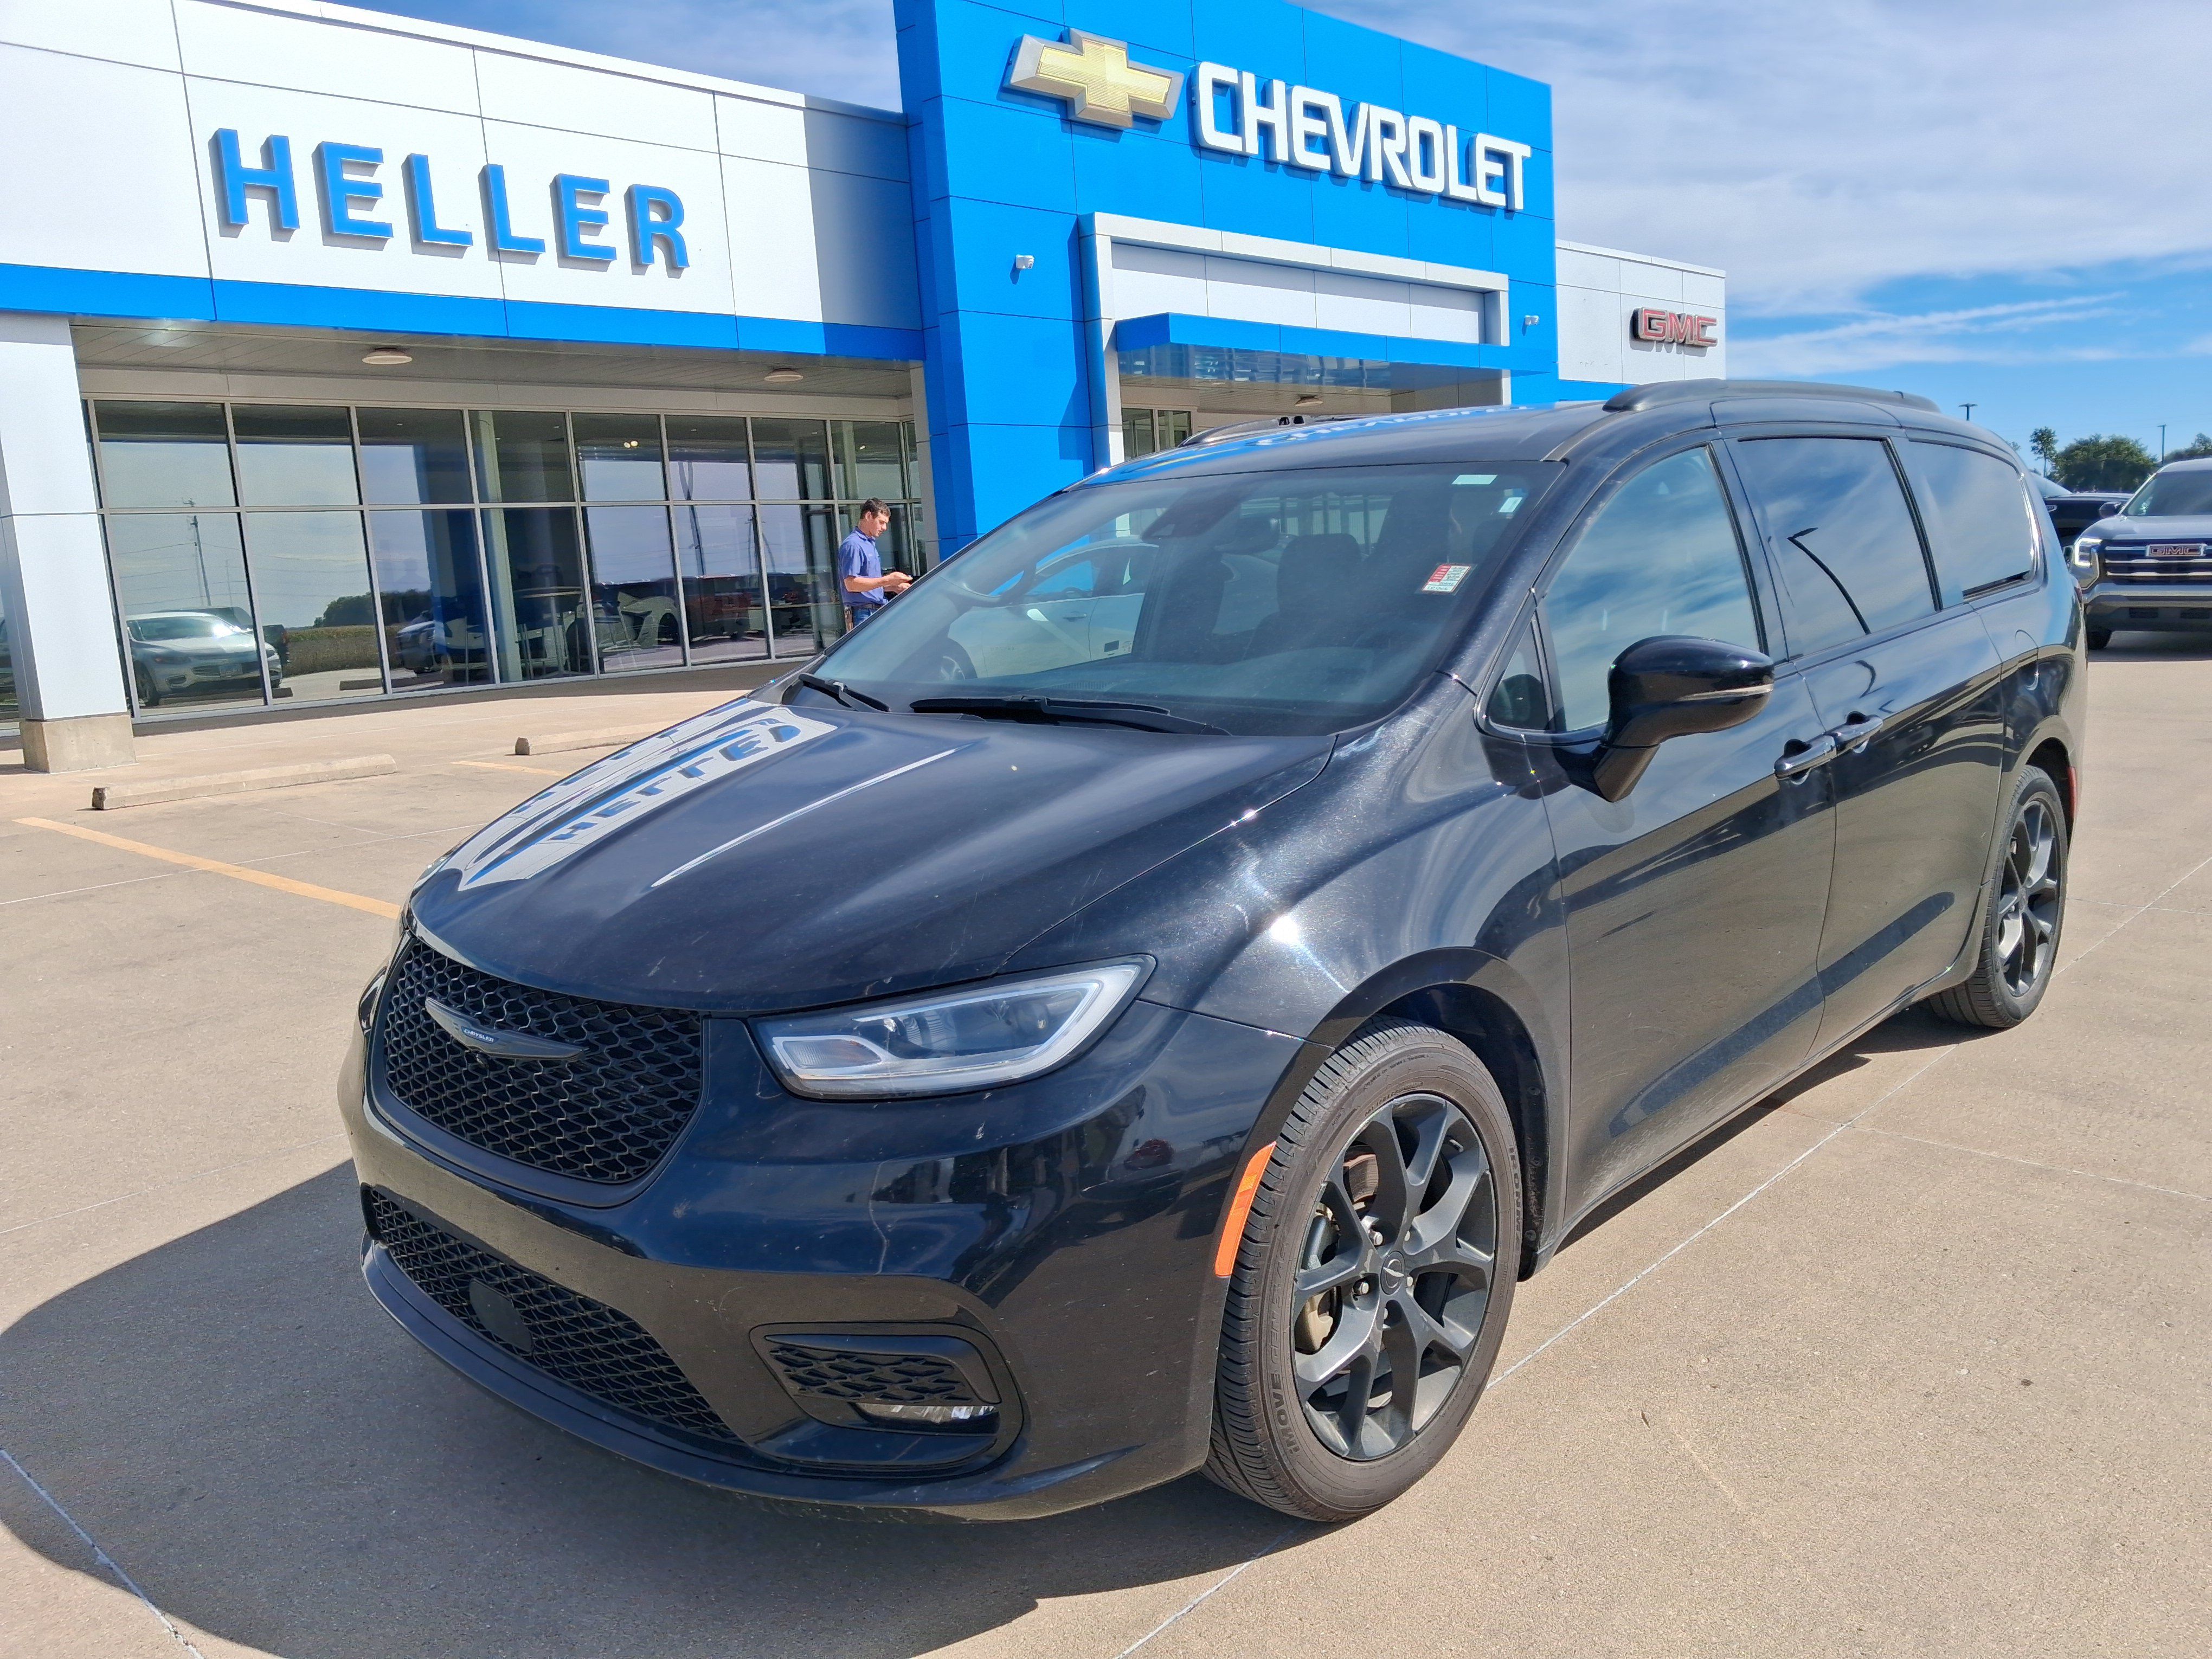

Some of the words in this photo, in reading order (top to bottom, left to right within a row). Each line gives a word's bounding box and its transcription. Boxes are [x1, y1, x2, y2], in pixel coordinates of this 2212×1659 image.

[1194, 61, 1532, 211] CHEVROLET
[211, 128, 690, 269] HELLER
[1635, 307, 1718, 347] GMC
[2150, 545, 2201, 555] GMC
[1270, 1373, 1300, 1454] iMOVE
